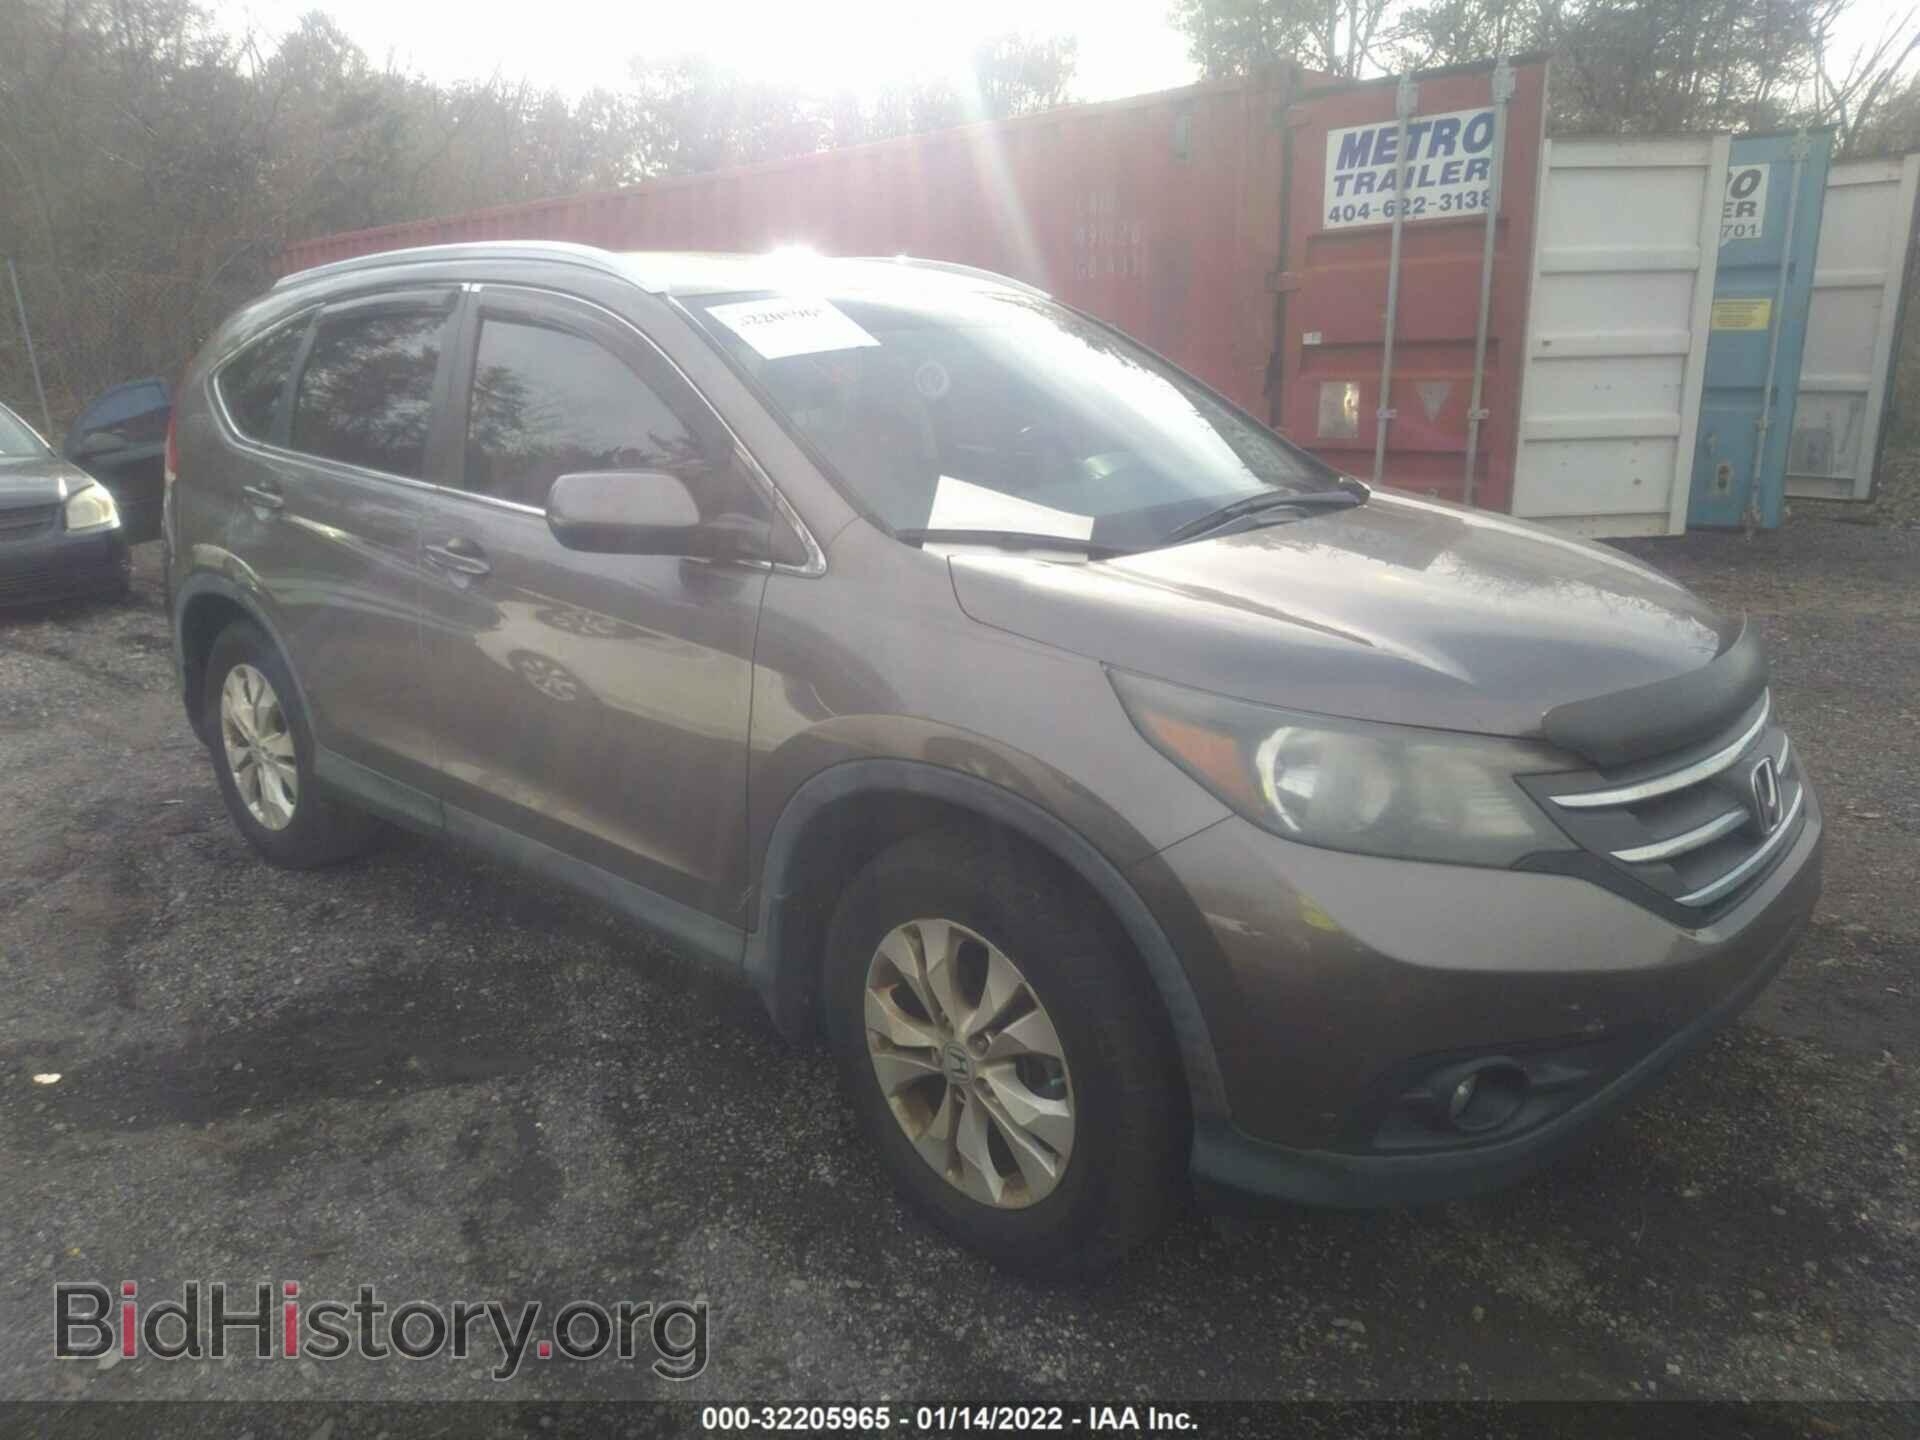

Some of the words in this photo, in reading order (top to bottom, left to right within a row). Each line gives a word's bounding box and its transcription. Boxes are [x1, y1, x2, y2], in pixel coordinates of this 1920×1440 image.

[1335, 111, 1496, 171] METRO
[1333, 157, 1491, 198] TRAILER
[1728, 168, 1762, 199] O
[1328, 189, 1489, 223] 404-622-3138
